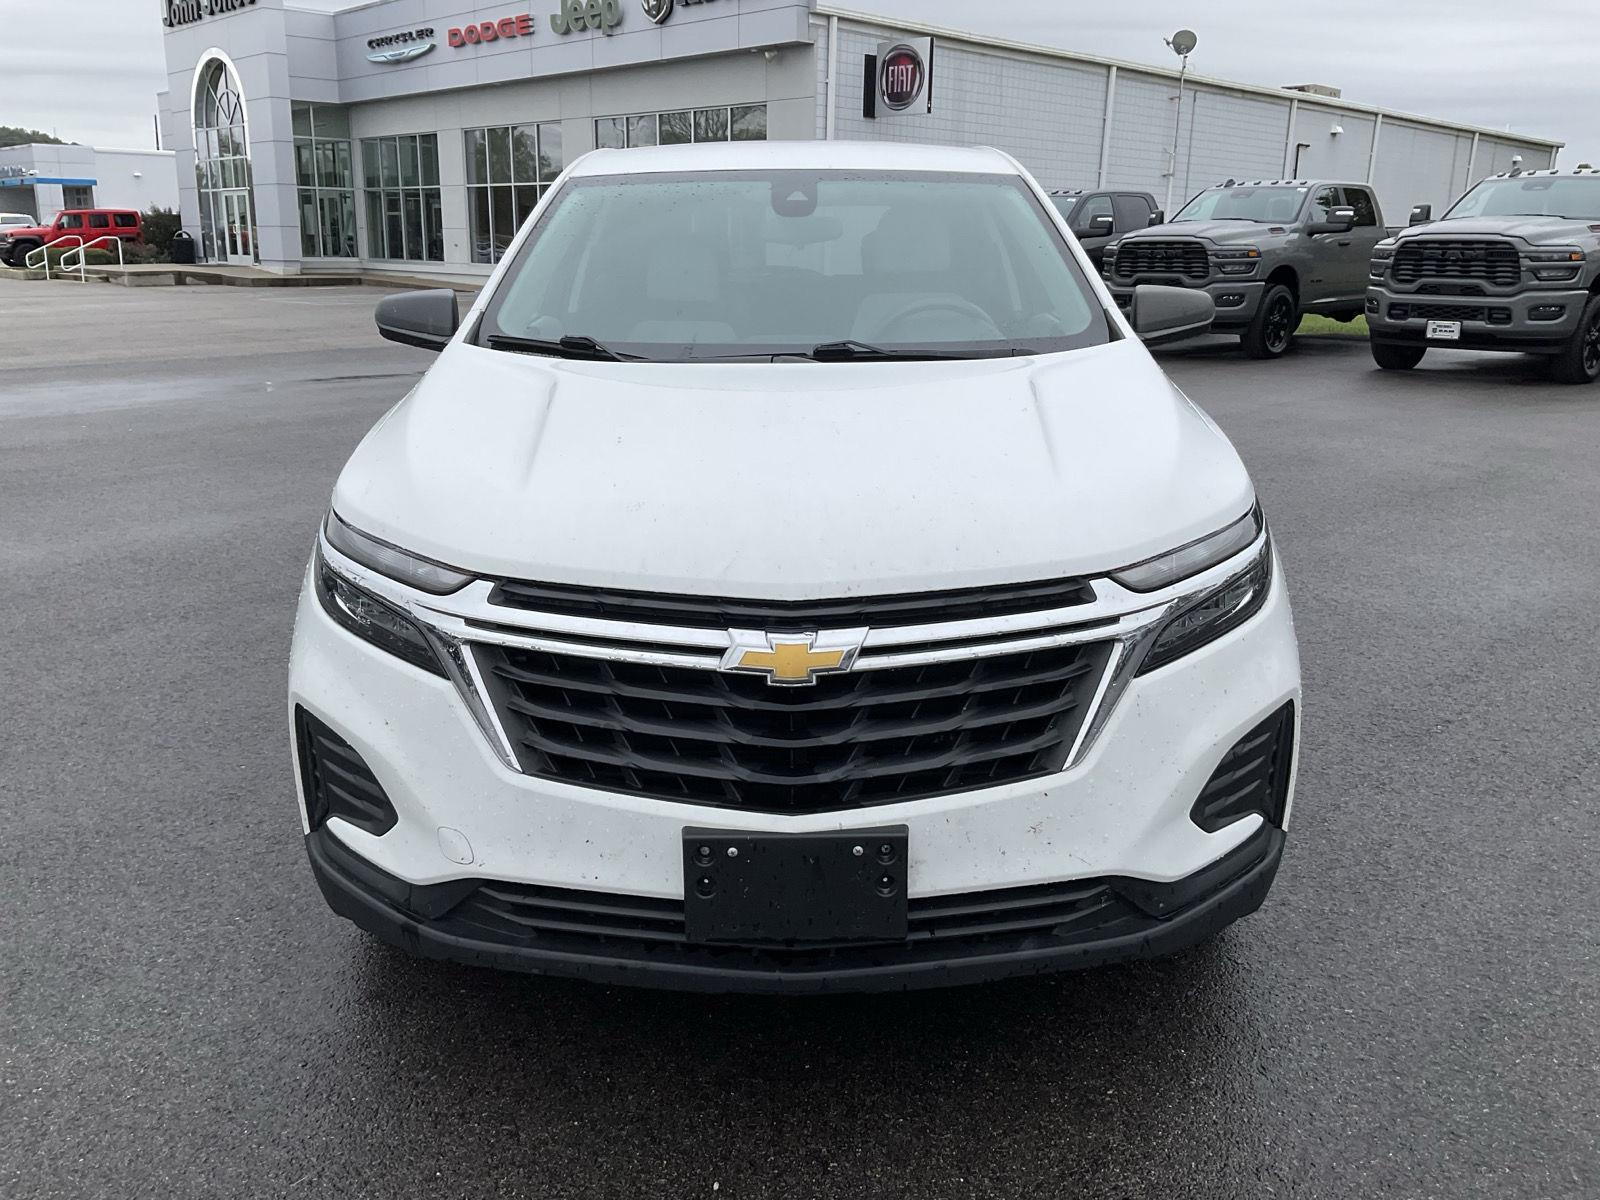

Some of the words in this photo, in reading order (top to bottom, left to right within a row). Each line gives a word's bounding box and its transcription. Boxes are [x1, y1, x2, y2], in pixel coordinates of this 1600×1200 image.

[162, 0, 200, 26] John
[550, 0, 620, 36] Jeep
[367, 27, 434, 49] CHRYSLER
[448, 14, 534, 47] DODGE
[887, 64, 914, 93] FIAT
